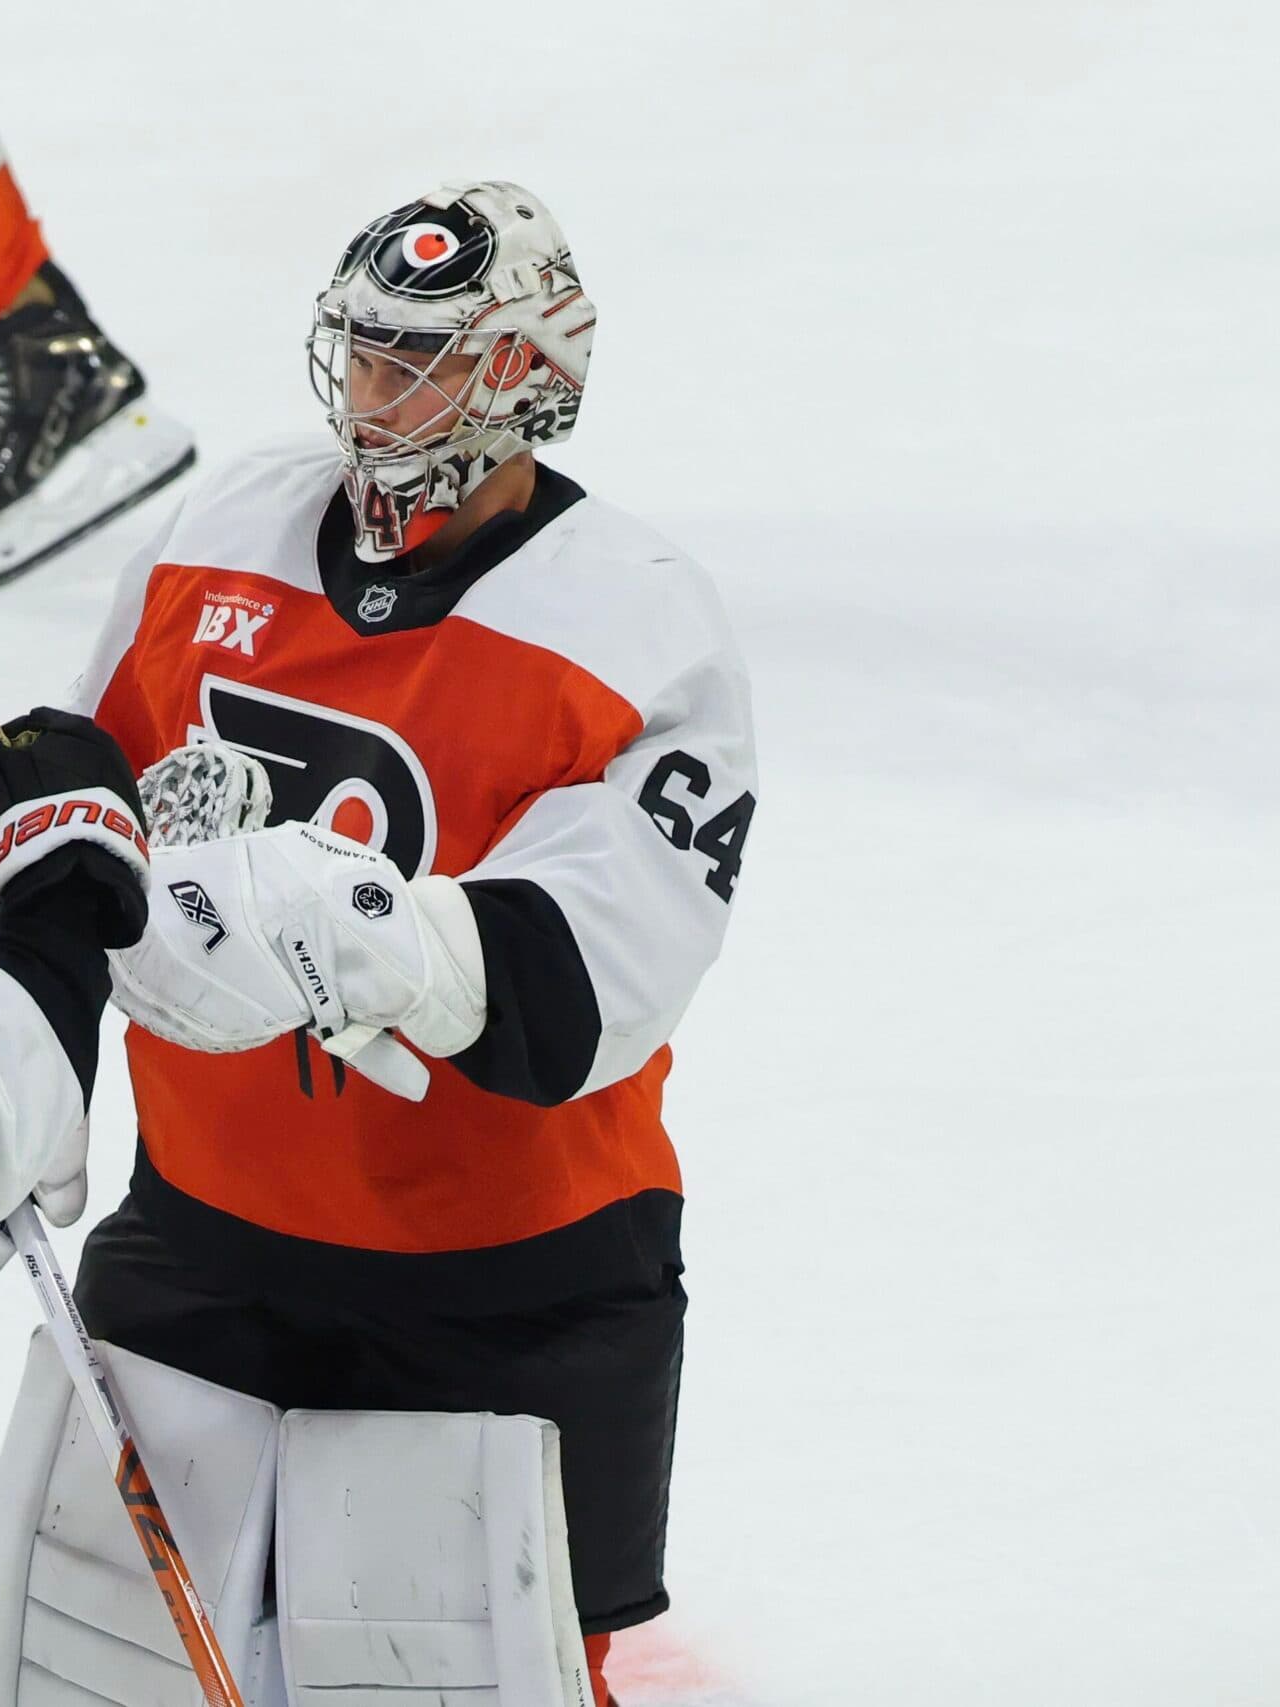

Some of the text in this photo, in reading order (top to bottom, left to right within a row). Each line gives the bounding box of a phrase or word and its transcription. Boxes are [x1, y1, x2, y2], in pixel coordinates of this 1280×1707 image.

[204, 589, 262, 611] Independence
[300, 828, 378, 863] BJARNASON
[637, 748, 757, 906] 64
[291, 939, 330, 1007] VAUGHN
[52, 1271, 86, 1335] BJARNASON
